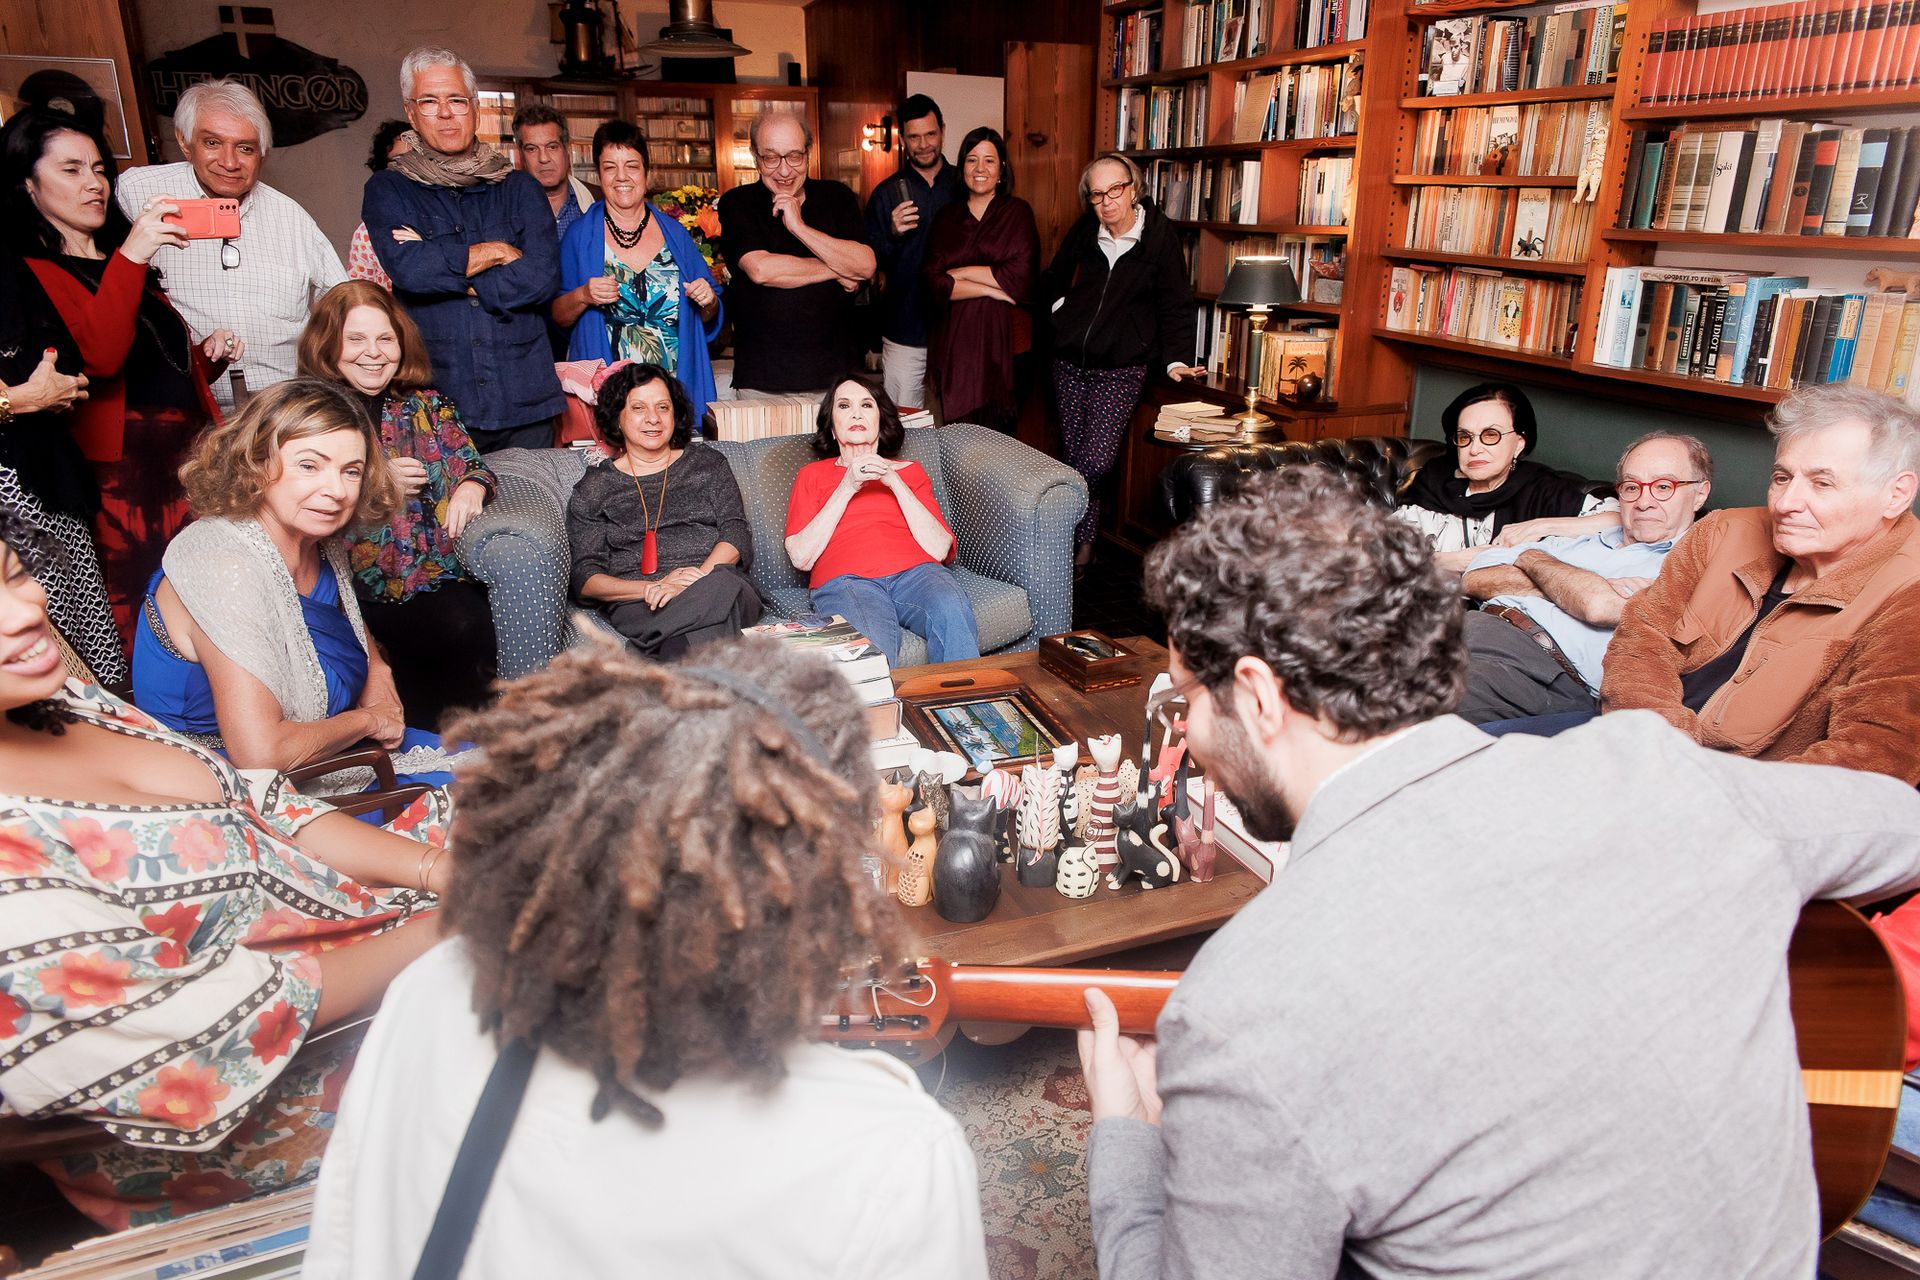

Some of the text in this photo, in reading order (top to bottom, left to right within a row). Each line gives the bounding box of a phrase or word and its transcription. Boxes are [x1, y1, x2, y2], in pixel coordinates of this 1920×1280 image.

[1715, 162, 1733, 177] Saki
[1682, 326, 1692, 357] POSSESSED
[1710, 304, 1725, 352] THE IDIOT
